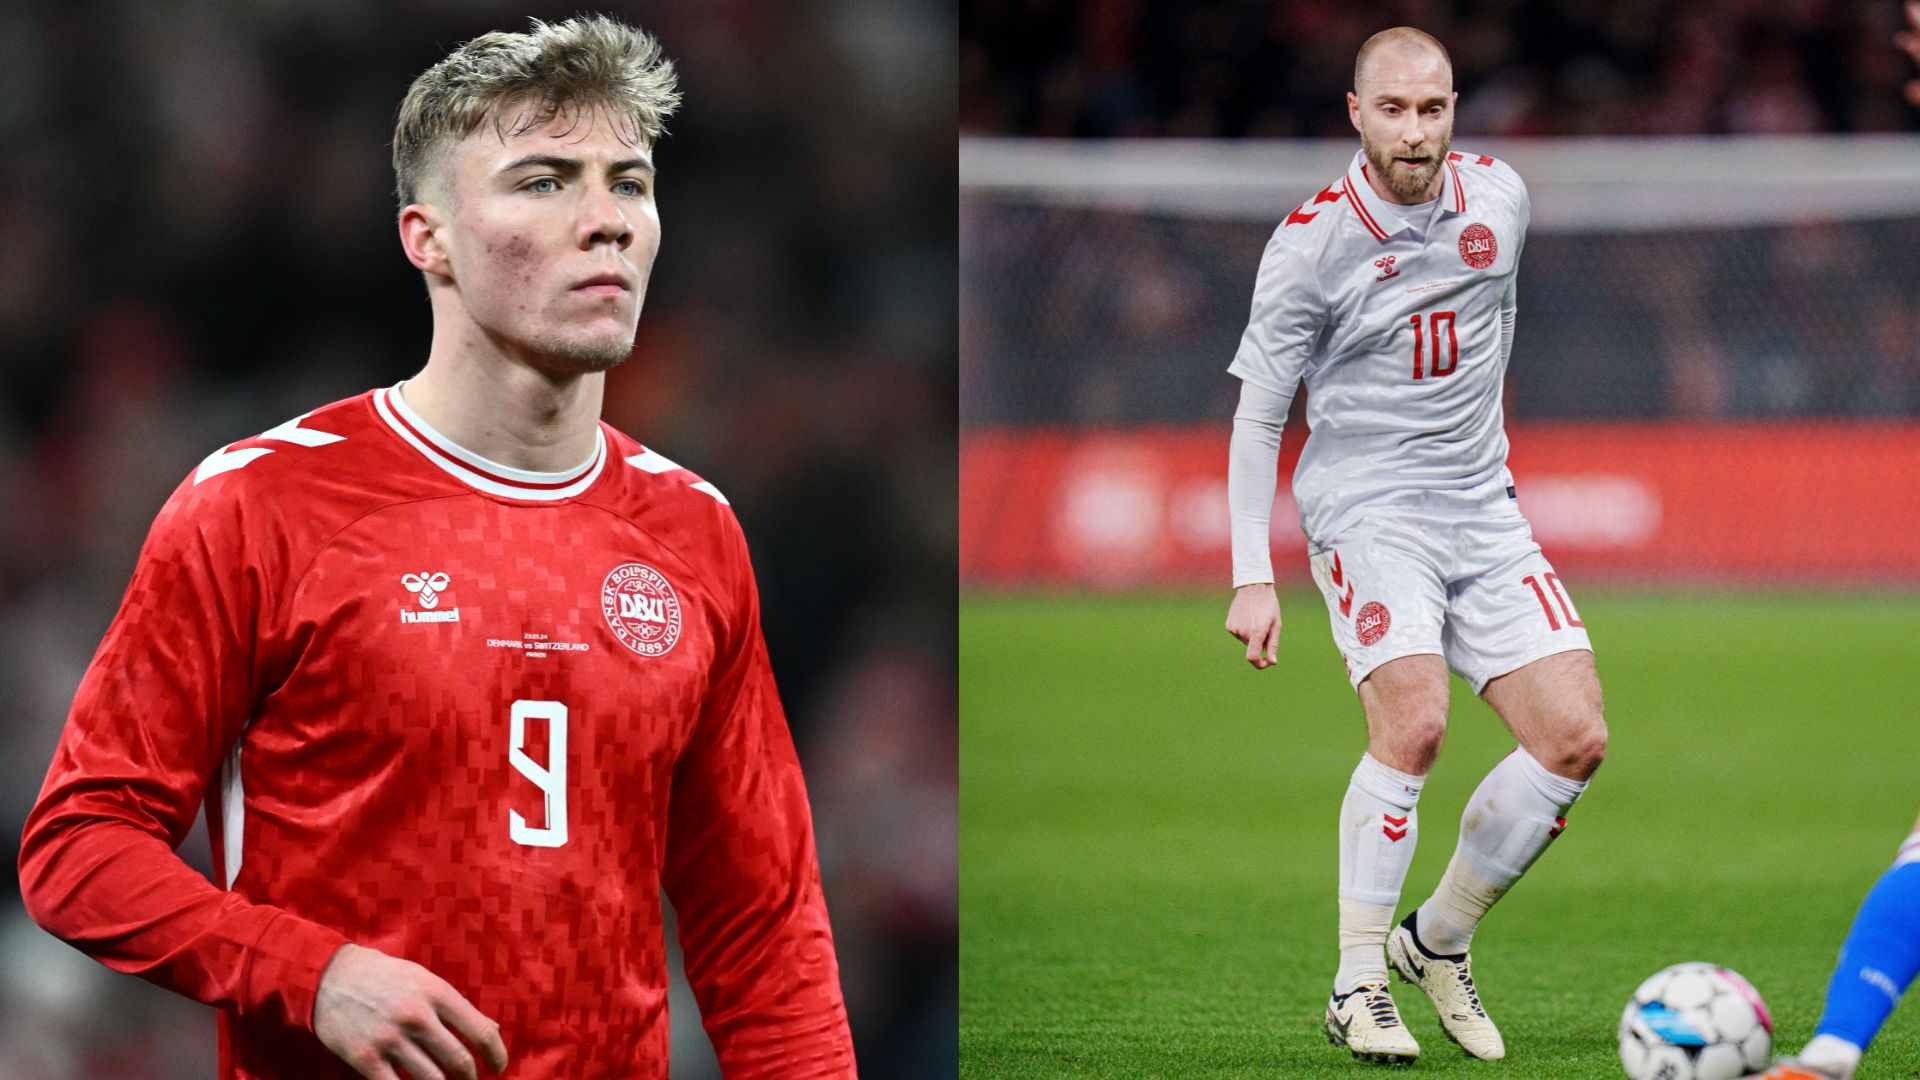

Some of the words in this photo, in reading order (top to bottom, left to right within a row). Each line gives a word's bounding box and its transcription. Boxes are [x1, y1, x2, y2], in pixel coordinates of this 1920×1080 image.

[1467, 239, 1490, 254] DBU
[1409, 310, 1458, 380] 10
[400, 607, 459, 624] hummel
[604, 585, 627, 639] DANSK
[664, 597, 679, 645] UNION
[618, 593, 666, 623] DBU
[1360, 613, 1382, 633] DBU
[487, 639, 523, 649] DENMARK
[533, 642, 589, 651] SWITZERLAND
[631, 640, 663, 653] 1889
[509, 699, 568, 848] 9
